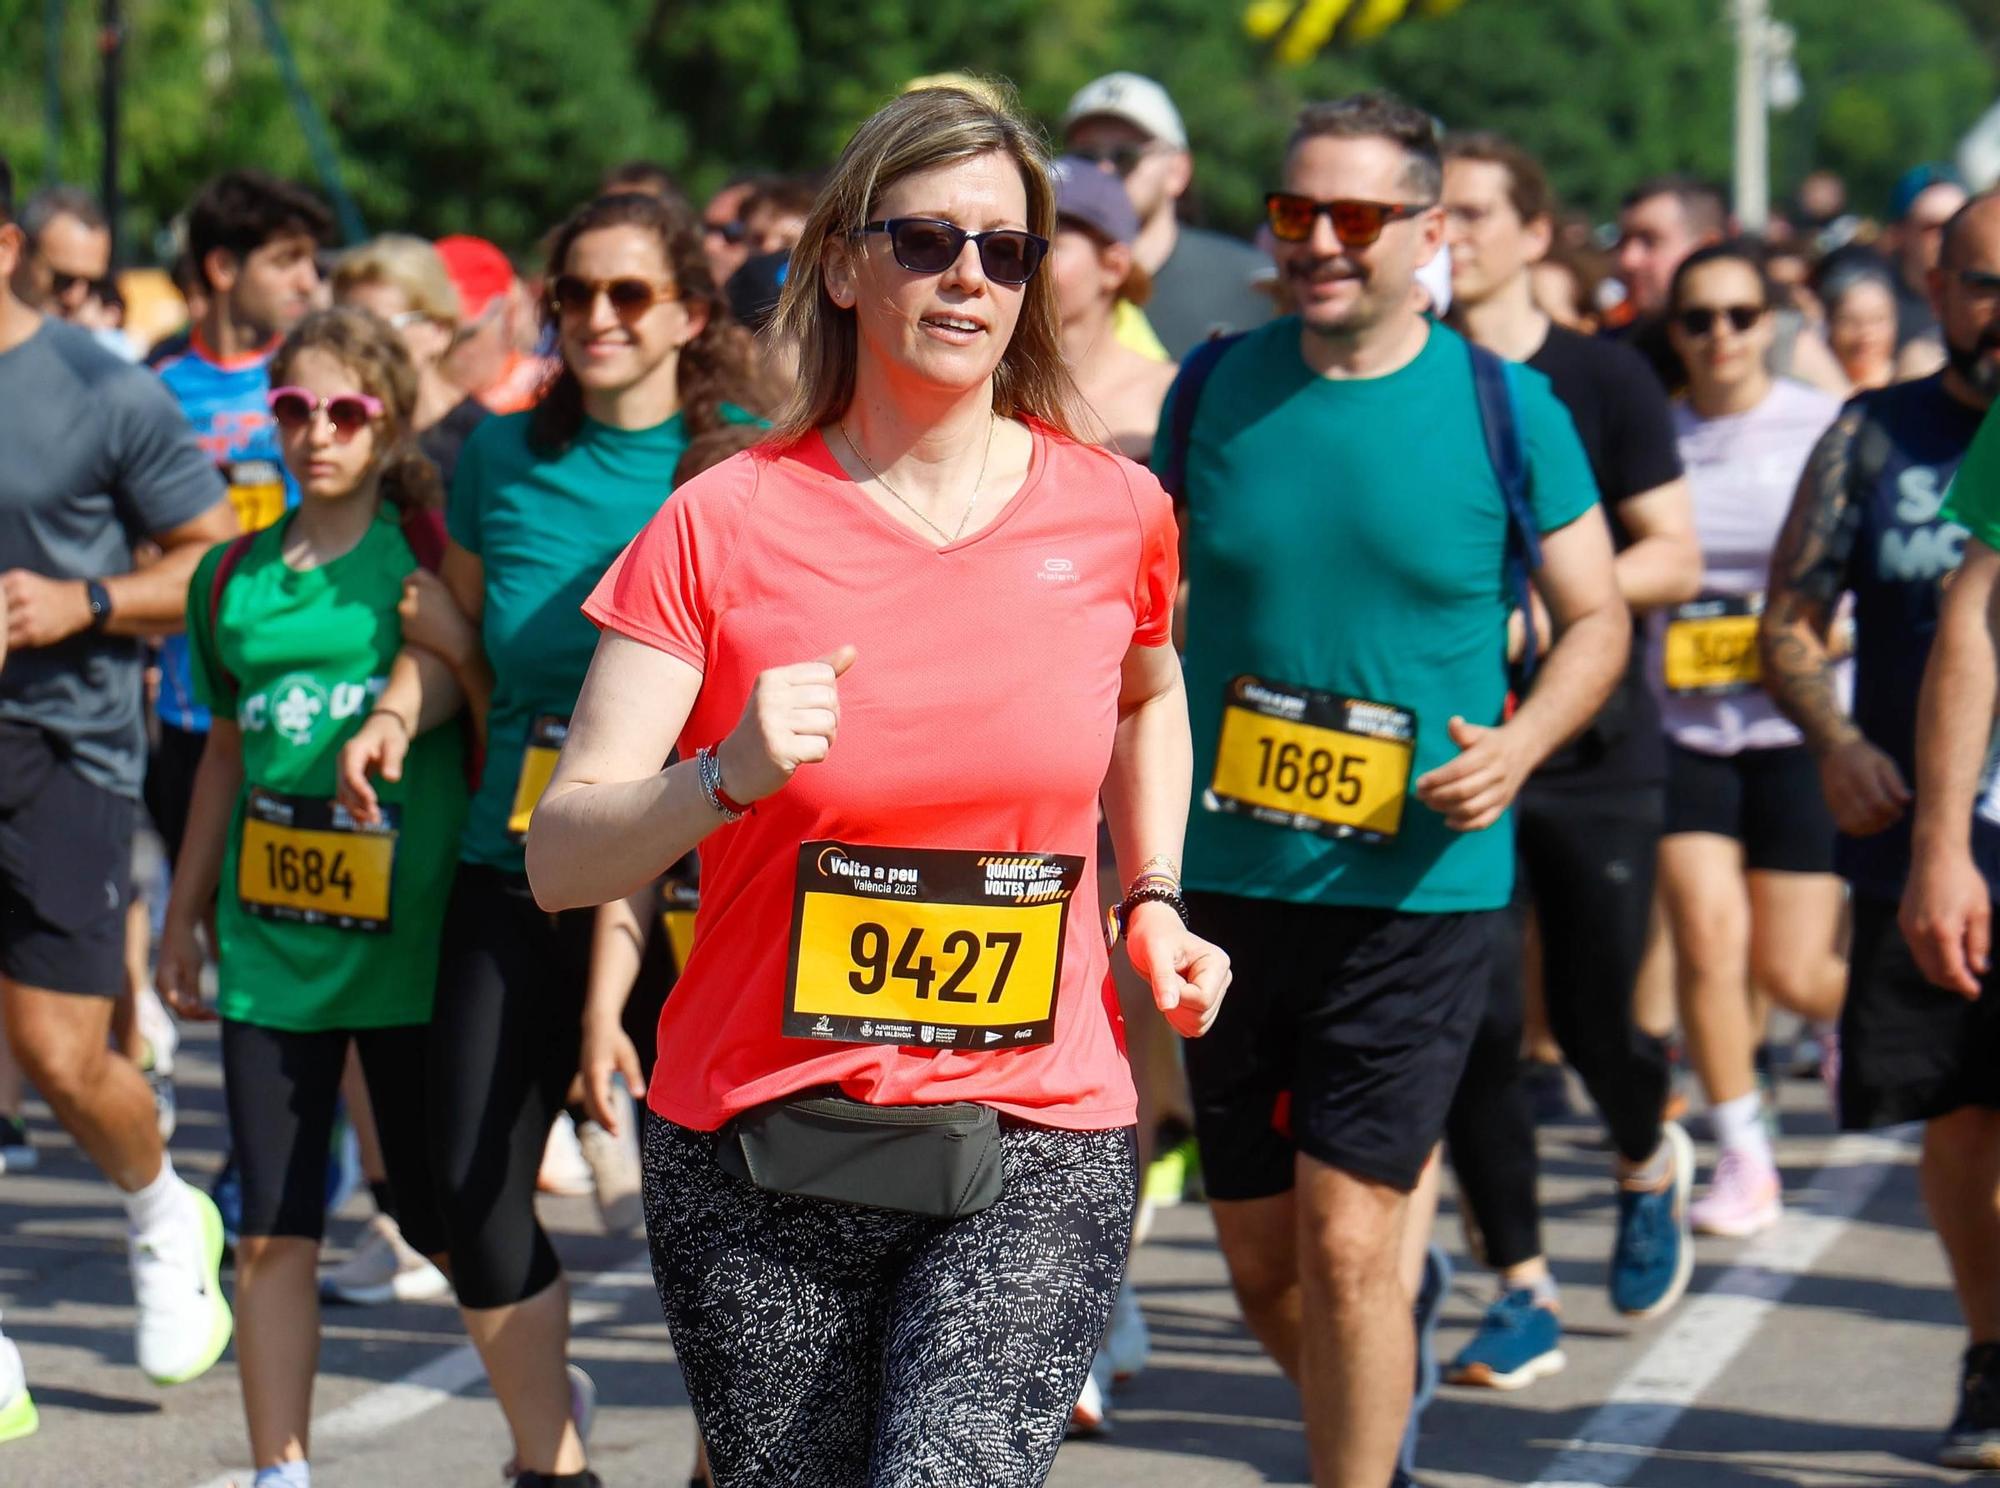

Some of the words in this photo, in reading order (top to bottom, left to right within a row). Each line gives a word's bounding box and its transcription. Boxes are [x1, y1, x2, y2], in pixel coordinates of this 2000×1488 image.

[1258, 736, 1367, 807] 1685
[264, 840, 354, 900] 1684
[830, 855, 871, 877] Volta
[873, 866, 884, 880] a
[888, 867, 919, 884] peu
[986, 863, 1038, 880] QUANTES
[854, 879, 893, 894] València
[894, 883, 917, 896] 2025
[984, 879, 1025, 897] VOLTES
[848, 921, 1023, 1005] 9427
[875, 1024, 912, 1033] AJUNTAMENT
